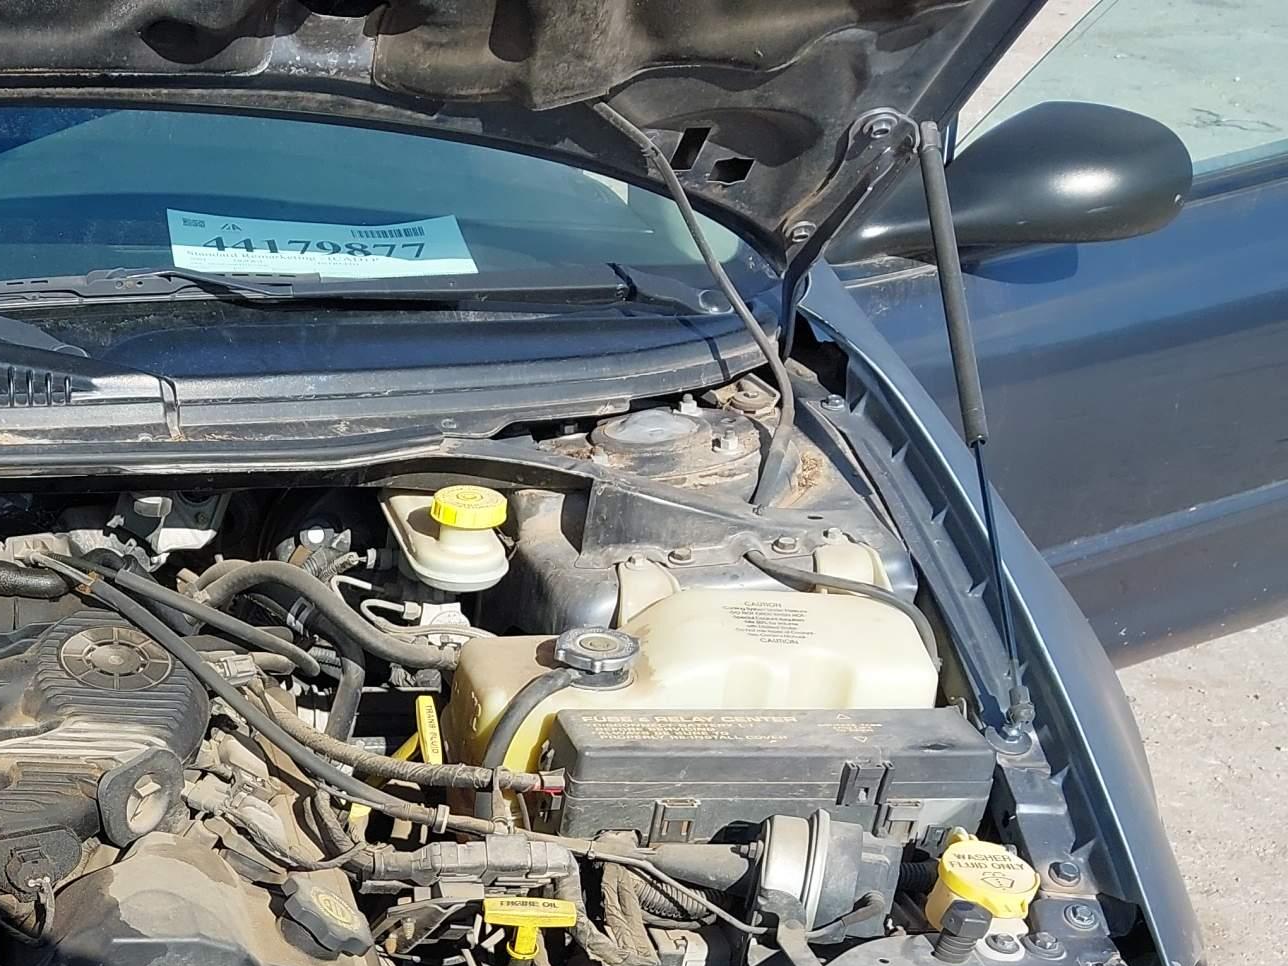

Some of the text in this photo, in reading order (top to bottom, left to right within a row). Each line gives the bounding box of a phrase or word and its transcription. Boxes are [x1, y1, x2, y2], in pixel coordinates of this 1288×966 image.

[202, 236, 425, 258] 44179877
[953, 852, 1012, 863] WASHER
[950, 861, 1025, 871] FLUID ONLY
